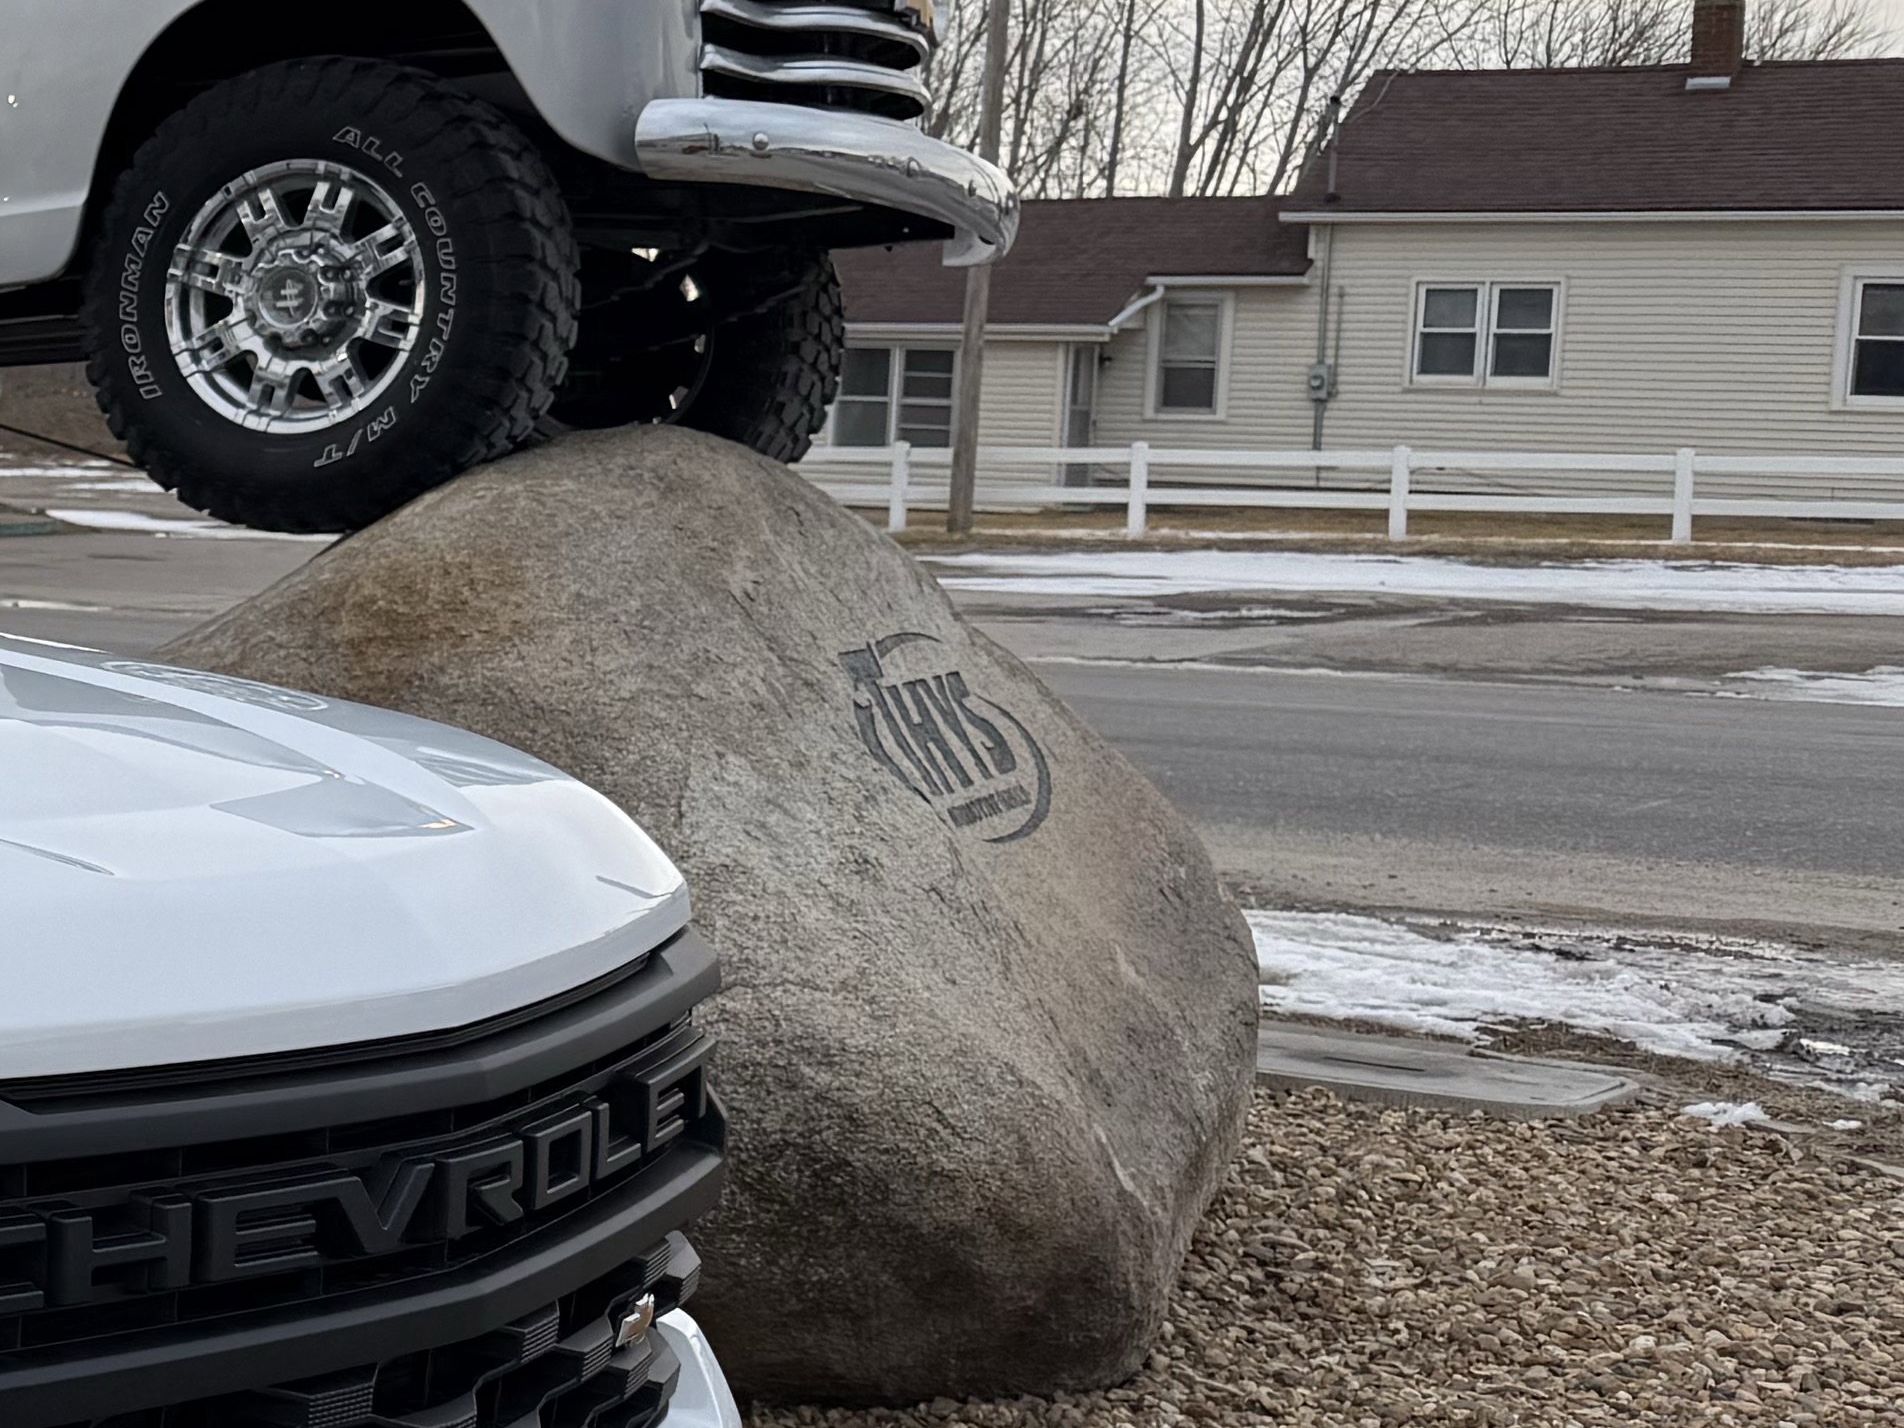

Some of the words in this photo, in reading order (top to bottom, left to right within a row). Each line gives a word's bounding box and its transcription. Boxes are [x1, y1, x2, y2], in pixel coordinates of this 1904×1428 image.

[332, 125, 404, 178] ALL
[118, 192, 171, 400] IRONMAN
[409, 181, 458, 403] COUNTRY
[313, 405, 398, 468] M/T
[838, 641, 1018, 797] THYS
